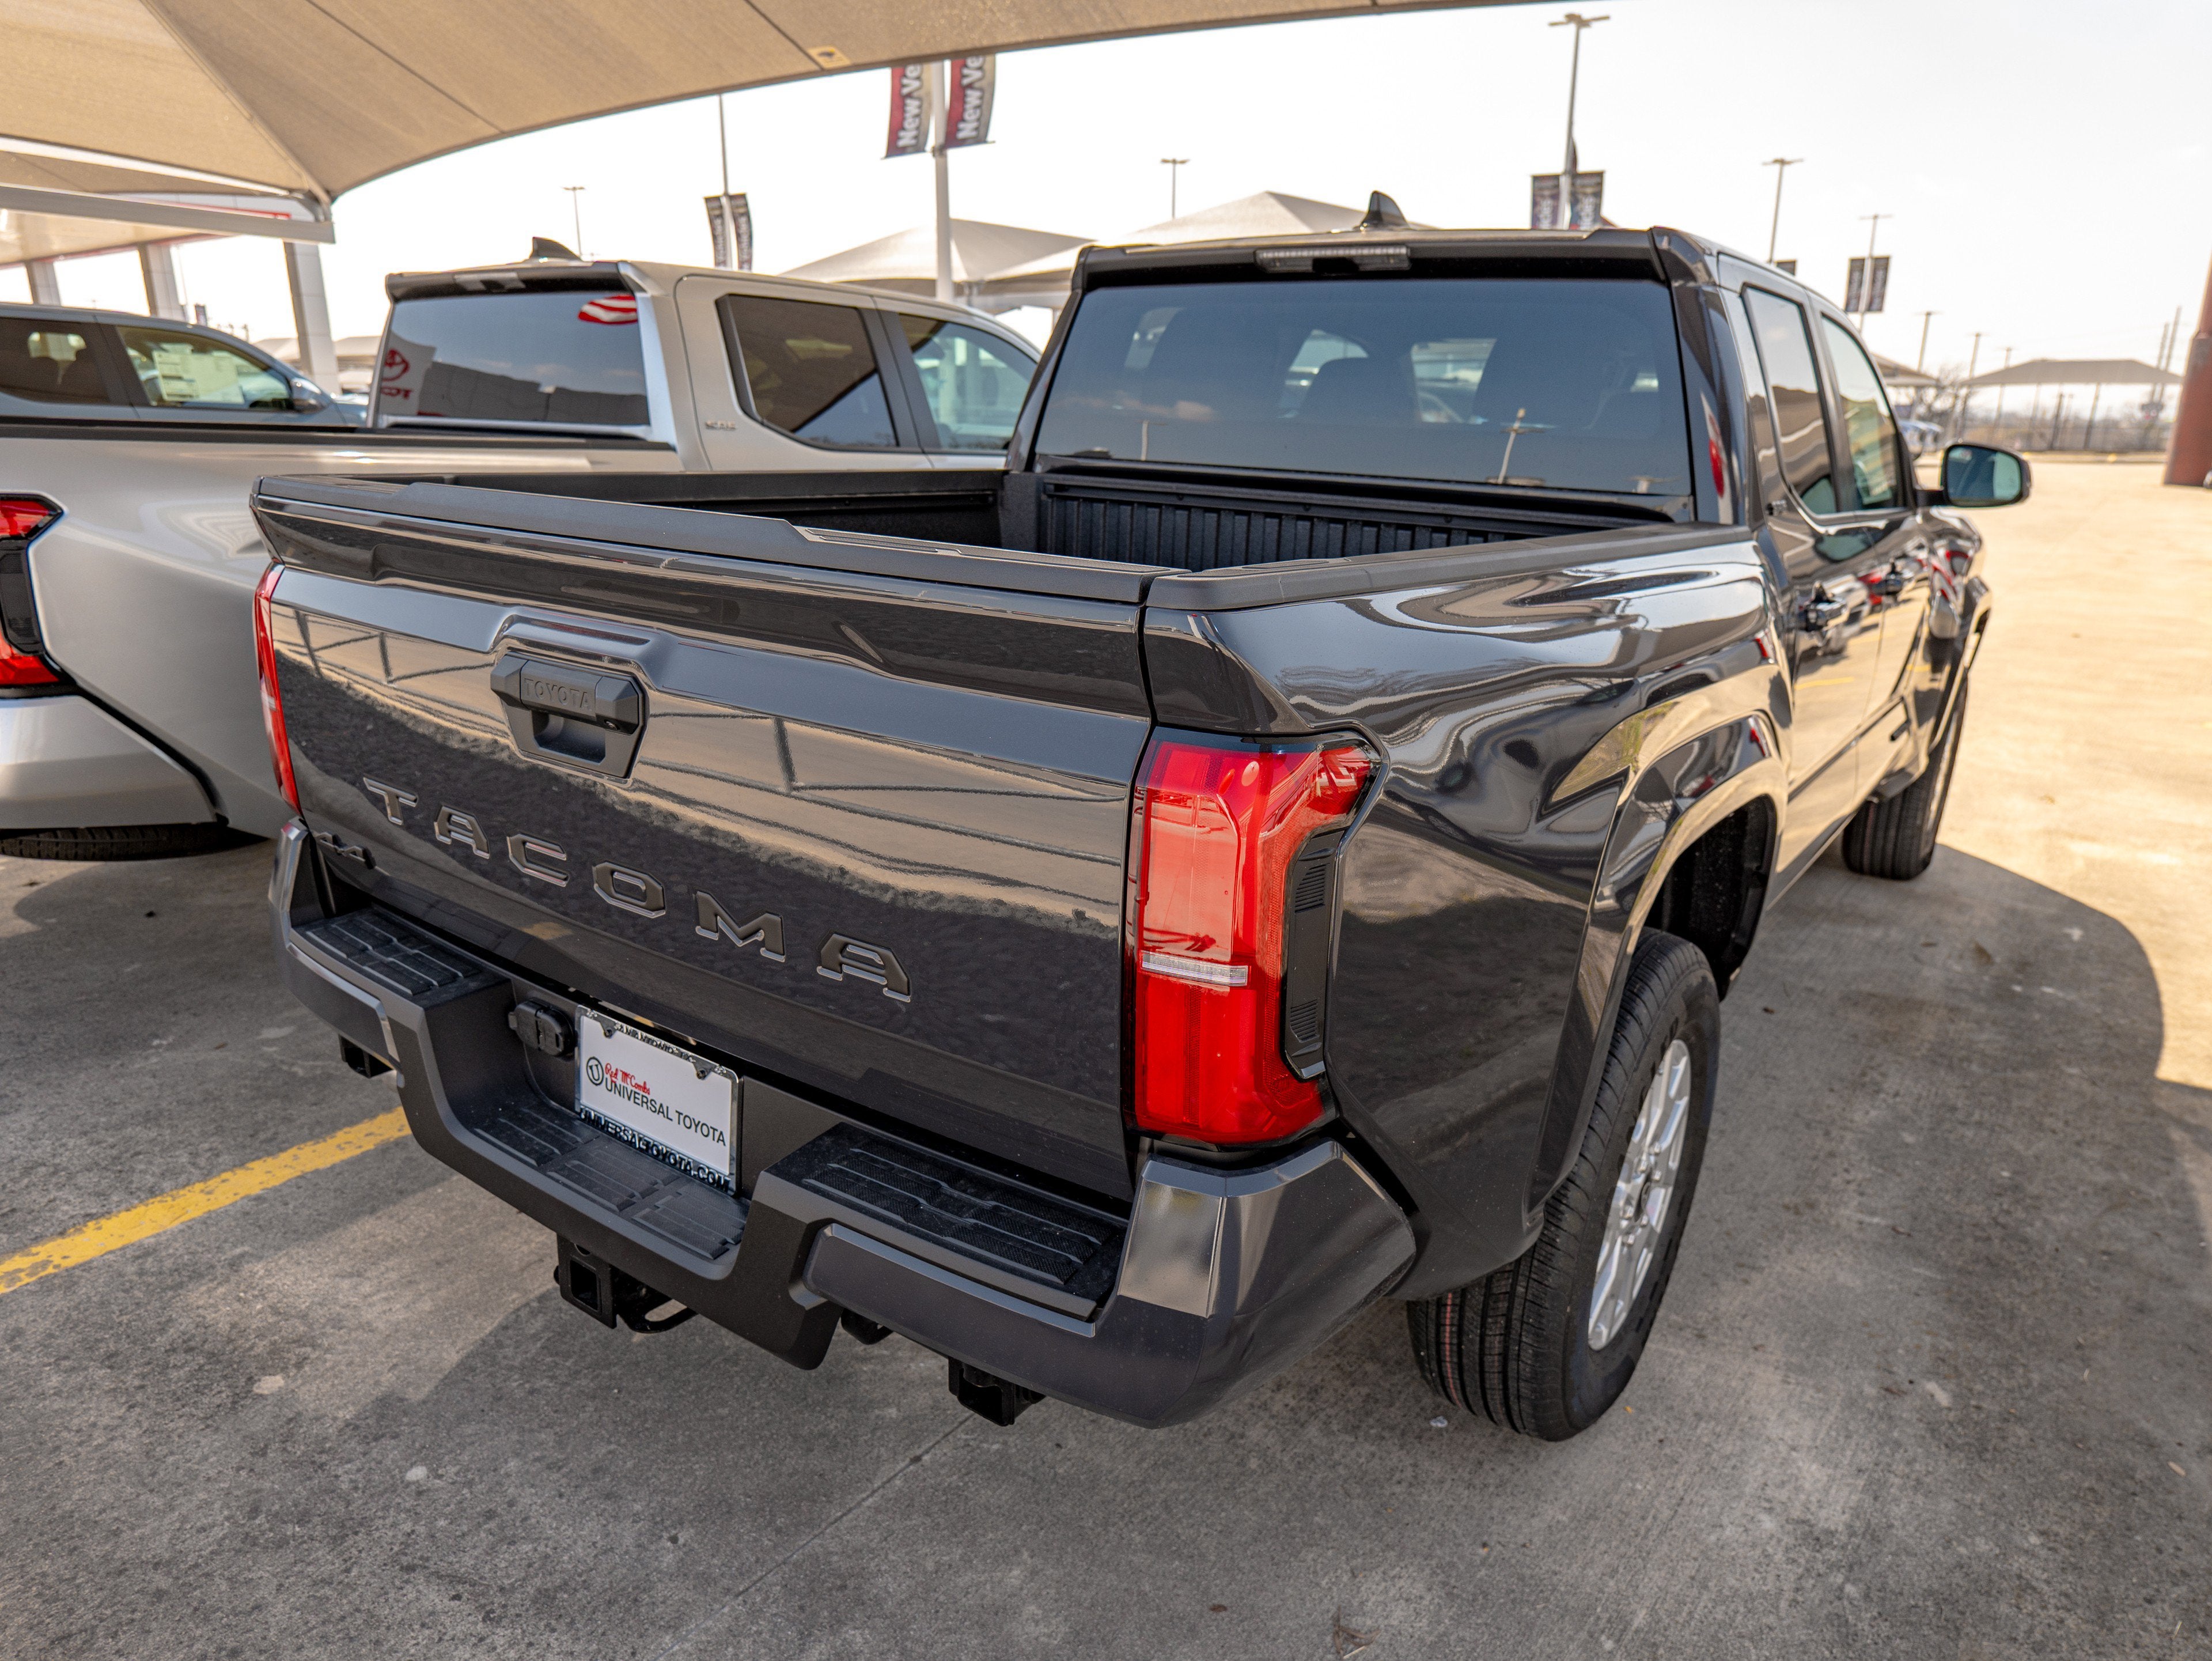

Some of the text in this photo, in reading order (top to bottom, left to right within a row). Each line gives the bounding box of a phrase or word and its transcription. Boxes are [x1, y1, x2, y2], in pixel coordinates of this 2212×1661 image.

[896, 97, 922, 147] New
[956, 88, 983, 139] New
[524, 678, 592, 712] TOYOTA
[362, 776, 912, 1002] TACOMA
[605, 1062, 619, 1083] Red
[605, 1077, 726, 1147] UNIVERSAL TOYOTA
